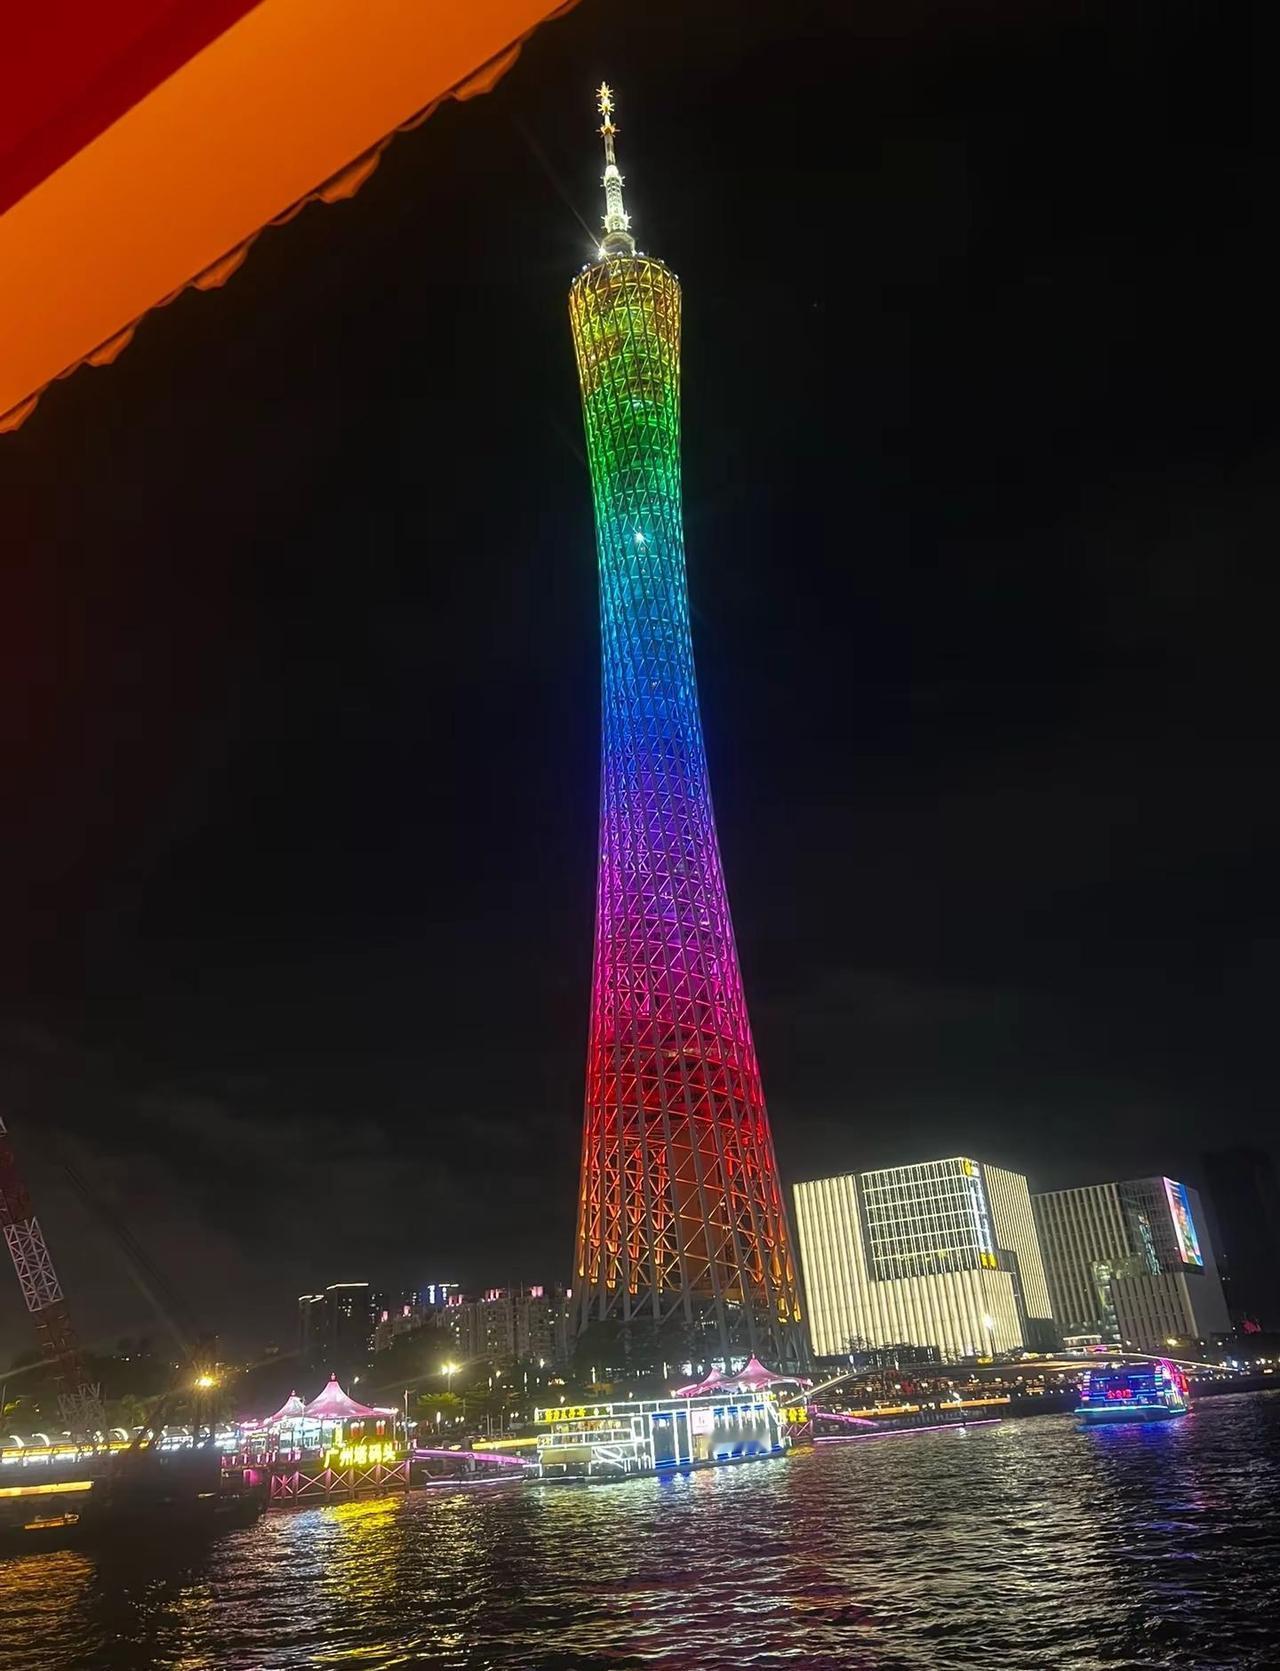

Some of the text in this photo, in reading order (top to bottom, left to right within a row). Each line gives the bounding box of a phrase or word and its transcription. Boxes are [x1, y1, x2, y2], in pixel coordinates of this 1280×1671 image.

[323, 1442, 396, 1468] 广州塔码头
